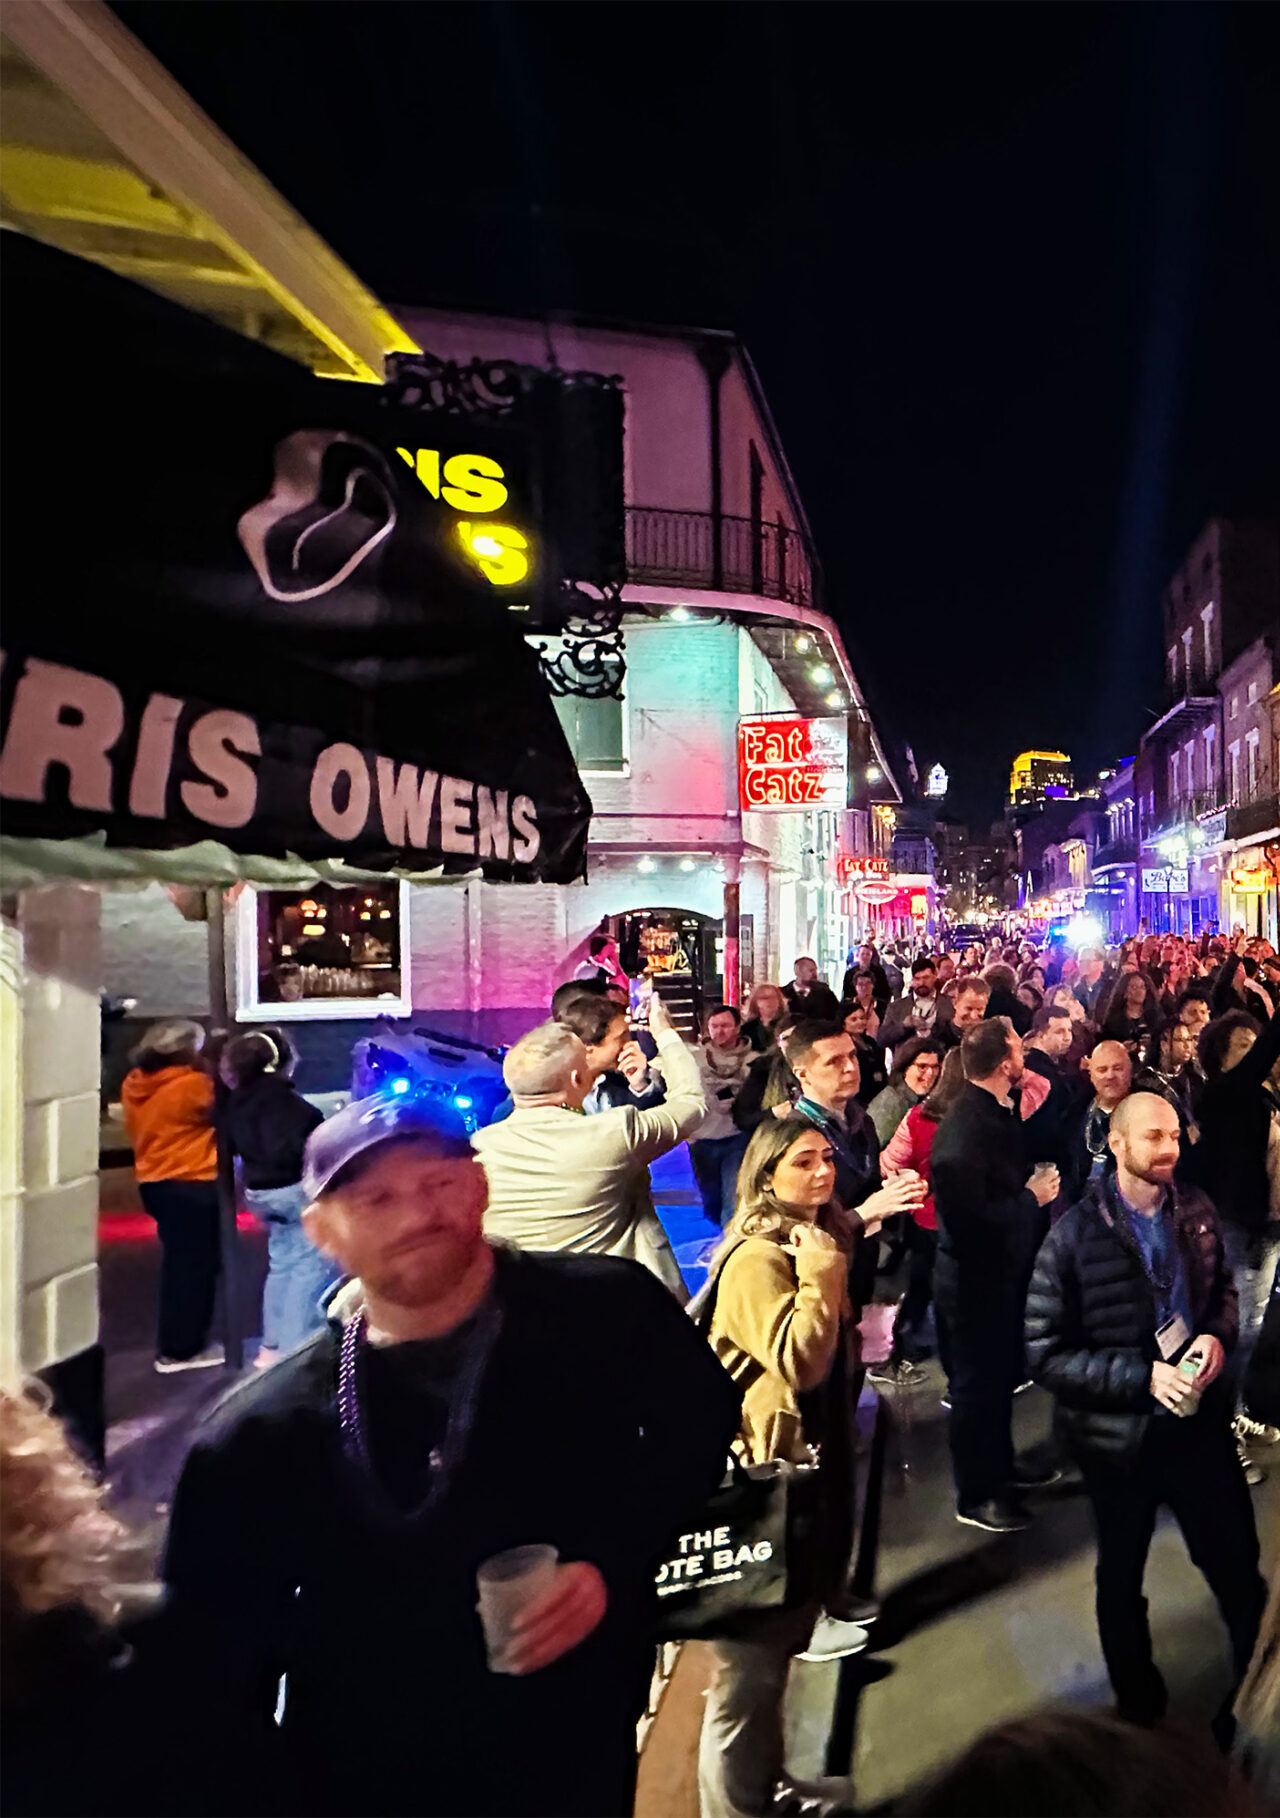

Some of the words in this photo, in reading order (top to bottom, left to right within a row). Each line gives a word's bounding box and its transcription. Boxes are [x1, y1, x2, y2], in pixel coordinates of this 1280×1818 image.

[396, 446, 508, 513] IS
[0, 648, 263, 829] RIS
[310, 742, 540, 864] OWENS
[742, 726, 803, 763] Fat
[746, 767, 823, 803] Catz
[678, 1526, 731, 1553] THE
[713, 1541, 773, 1570] BAG
